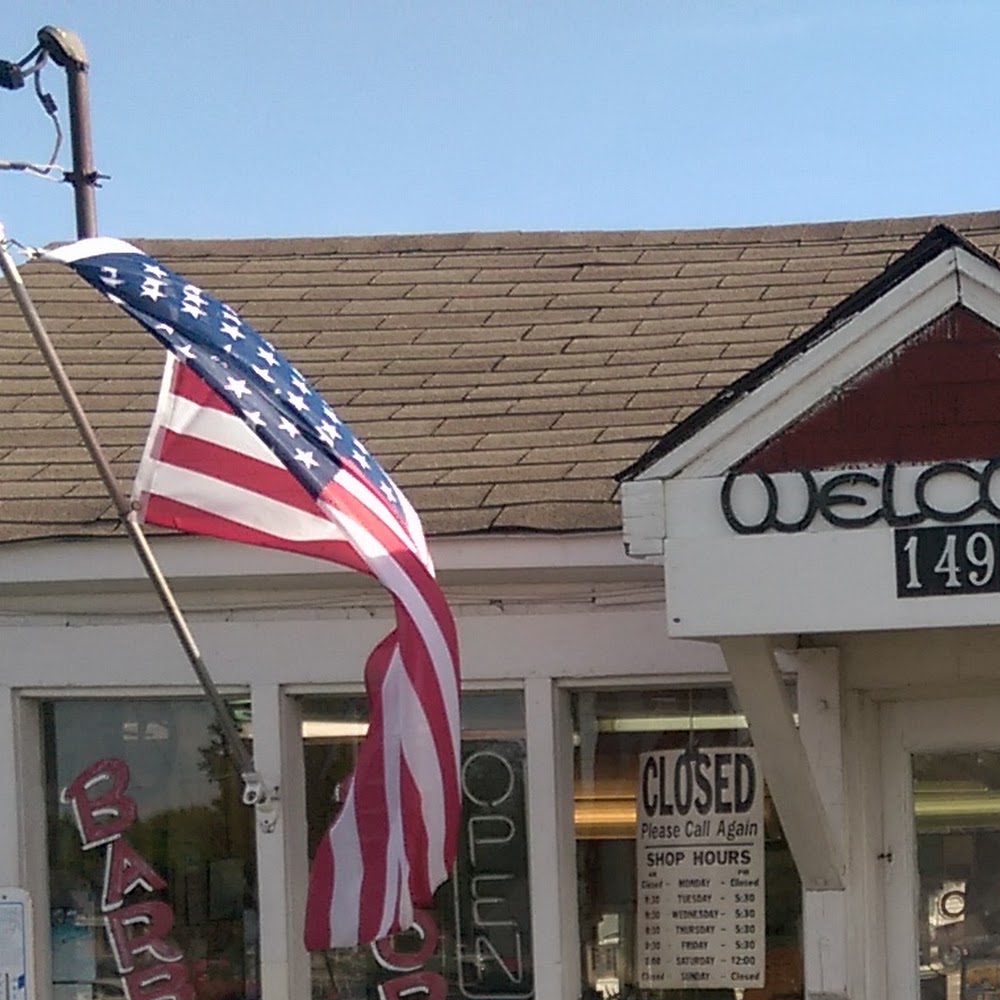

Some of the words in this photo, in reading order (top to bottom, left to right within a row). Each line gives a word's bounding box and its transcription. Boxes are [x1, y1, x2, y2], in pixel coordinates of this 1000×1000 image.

[642, 753, 756, 817] CLOSED
[641, 822, 681, 840] Please
[685, 820, 711, 838] Call
[717, 820, 758, 841] Again
[647, 852, 685, 867] SHOP
[693, 850, 752, 866] HOURS
[462, 751, 524, 985] OPEN
[678, 878, 710, 887] MONDAY
[730, 878, 760, 887] Closed
[677, 894, 712, 904] TUESDAY
[734, 893, 756, 902] 5:30
[672, 910, 719, 919] WEDNESDAY
[735, 909, 756, 918] 5:30
[676, 925, 716, 935] THURSDAY
[735, 925, 756, 934] 5:30
[681, 941, 709, 950] FRIDAY
[735, 940, 756, 950] 5:30
[676, 956, 715, 966] SATURDAY
[731, 956, 756, 965] 12:00
[680, 972, 710, 981] SUNDAY
[731, 972, 760, 982] Closed
